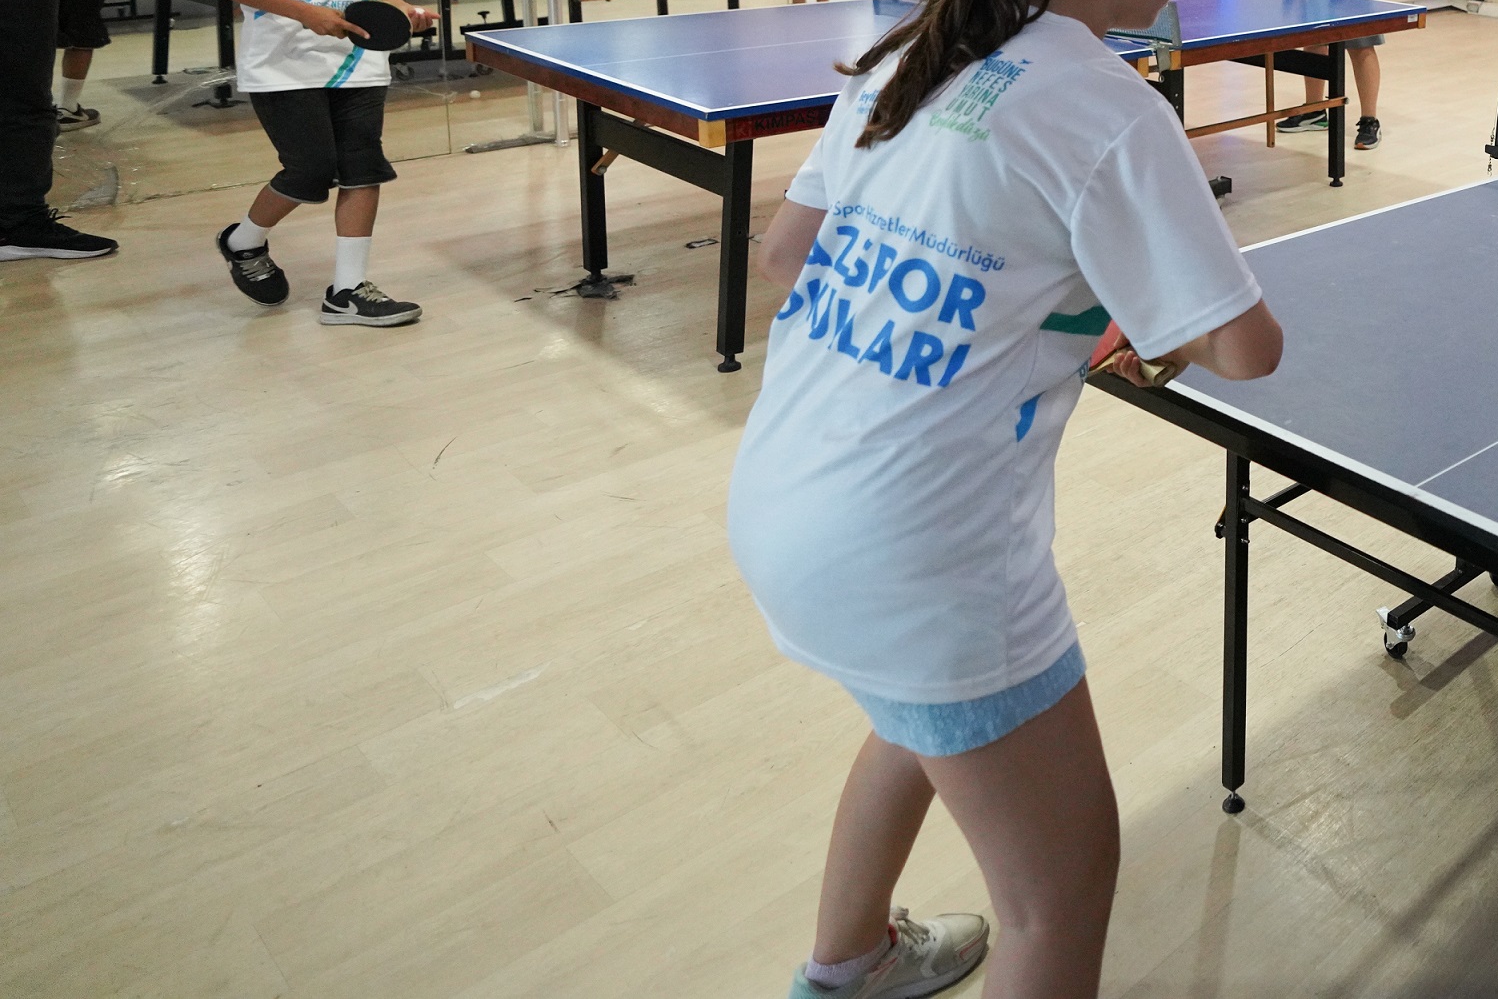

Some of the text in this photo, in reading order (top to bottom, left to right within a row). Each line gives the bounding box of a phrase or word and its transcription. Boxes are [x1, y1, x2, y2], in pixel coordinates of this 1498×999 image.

[970, 70, 1013, 94] NEFES
[959, 83, 1000, 107] YARINA
[945, 97, 991, 123] UMUT
[909, 226, 1005, 272] Müdürlüğü
